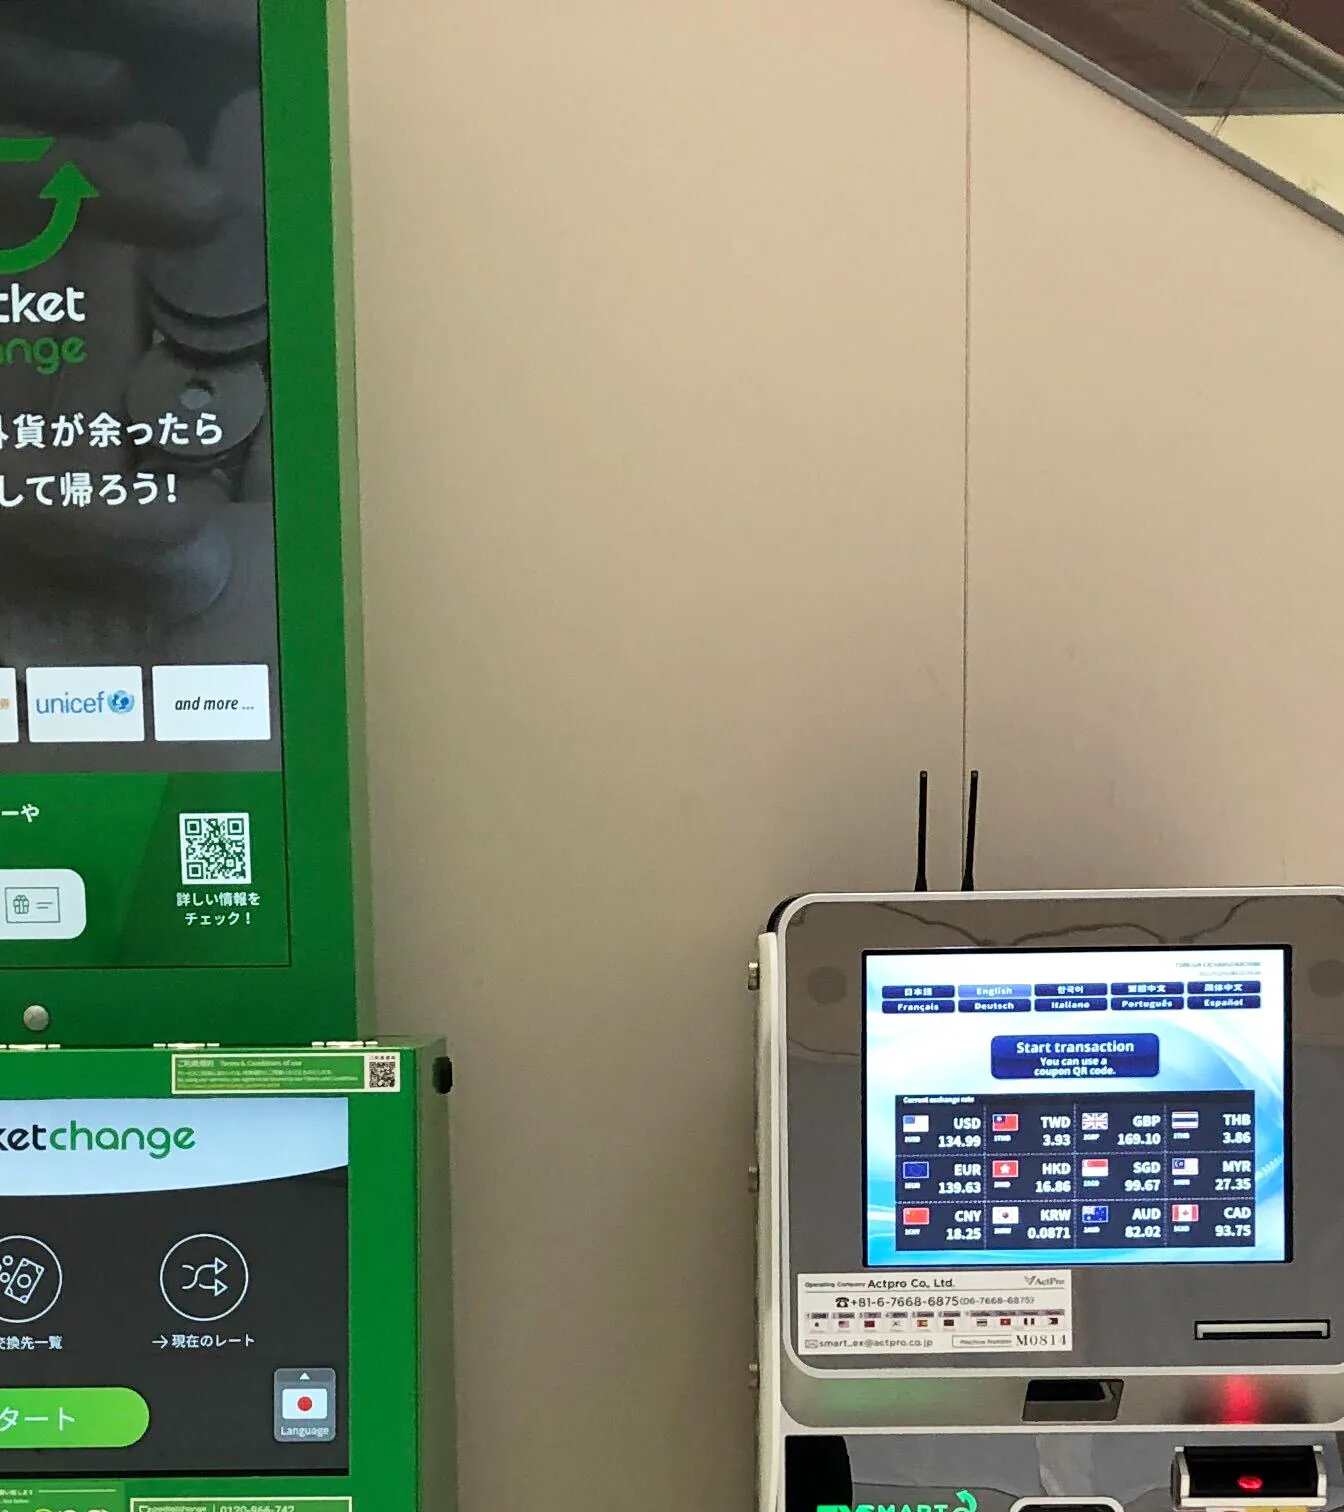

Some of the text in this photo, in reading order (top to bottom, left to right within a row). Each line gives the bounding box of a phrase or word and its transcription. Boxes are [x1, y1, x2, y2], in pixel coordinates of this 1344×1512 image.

[36, 691, 105, 714] unicef
[175, 697, 199, 711] and
[176, 892, 260, 906] 詳しい情報を
[185, 912, 251, 926] チェック！
[976, 987, 1013, 996] English
[897, 1003, 939, 1012] Français
[974, 1002, 1014, 1010] Deutsch
[1051, 1001, 1090, 1009] Italiano
[1122, 999, 1173, 1009] Português
[1204, 998, 1244, 1008] Español
[1017, 1039, 1135, 1054] Start transaction
[1040, 1057, 1059, 1066] You
[1061, 1058, 1079, 1066] can
[1082, 1058, 1099, 1066] use
[1034, 1067, 1070, 1077] coupon
[1072, 1067, 1088, 1076] QR
[953, 1117, 981, 1129] USD
[1040, 1116, 1071, 1128] TWD
[1132, 1115, 1161, 1127] GBP
[1223, 1113, 1251, 1126] THB
[938, 1135, 981, 1147] 134.99
[1042, 1134, 1071, 1146] 3.93
[1117, 1133, 1161, 1145] 169.10
[1222, 1132, 1251, 1144] 3.86
[954, 1164, 981, 1176] EUR
[1042, 1162, 1071, 1175] HKD
[1133, 1161, 1161, 1173] SGD
[1222, 1160, 1251, 1172] MYR
[938, 1182, 981, 1194] 139.63
[1035, 1180, 1071, 1192] 16.86
[1124, 1179, 1161, 1191] 99.67
[1214, 1178, 1251, 1190] 27.35
[954, 1210, 982, 1222] CNY
[1040, 1209, 1071, 1221] KRW
[1132, 1208, 1161, 1220] AUD
[1223, 1207, 1251, 1219] CAD
[946, 1227, 981, 1240] 18.25
[1027, 1227, 1071, 1239] 0.0871
[1124, 1226, 1161, 1238] 82.02
[1214, 1225, 1251, 1237] 93.75
[867, 1279, 907, 1289] Actpro
[934, 1278, 955, 1288] Ltd.
[171, 1334, 255, 1348] 現在のレート
[1016, 1334, 1067, 1346] M0814
[281, 1426, 329, 1437] Language
